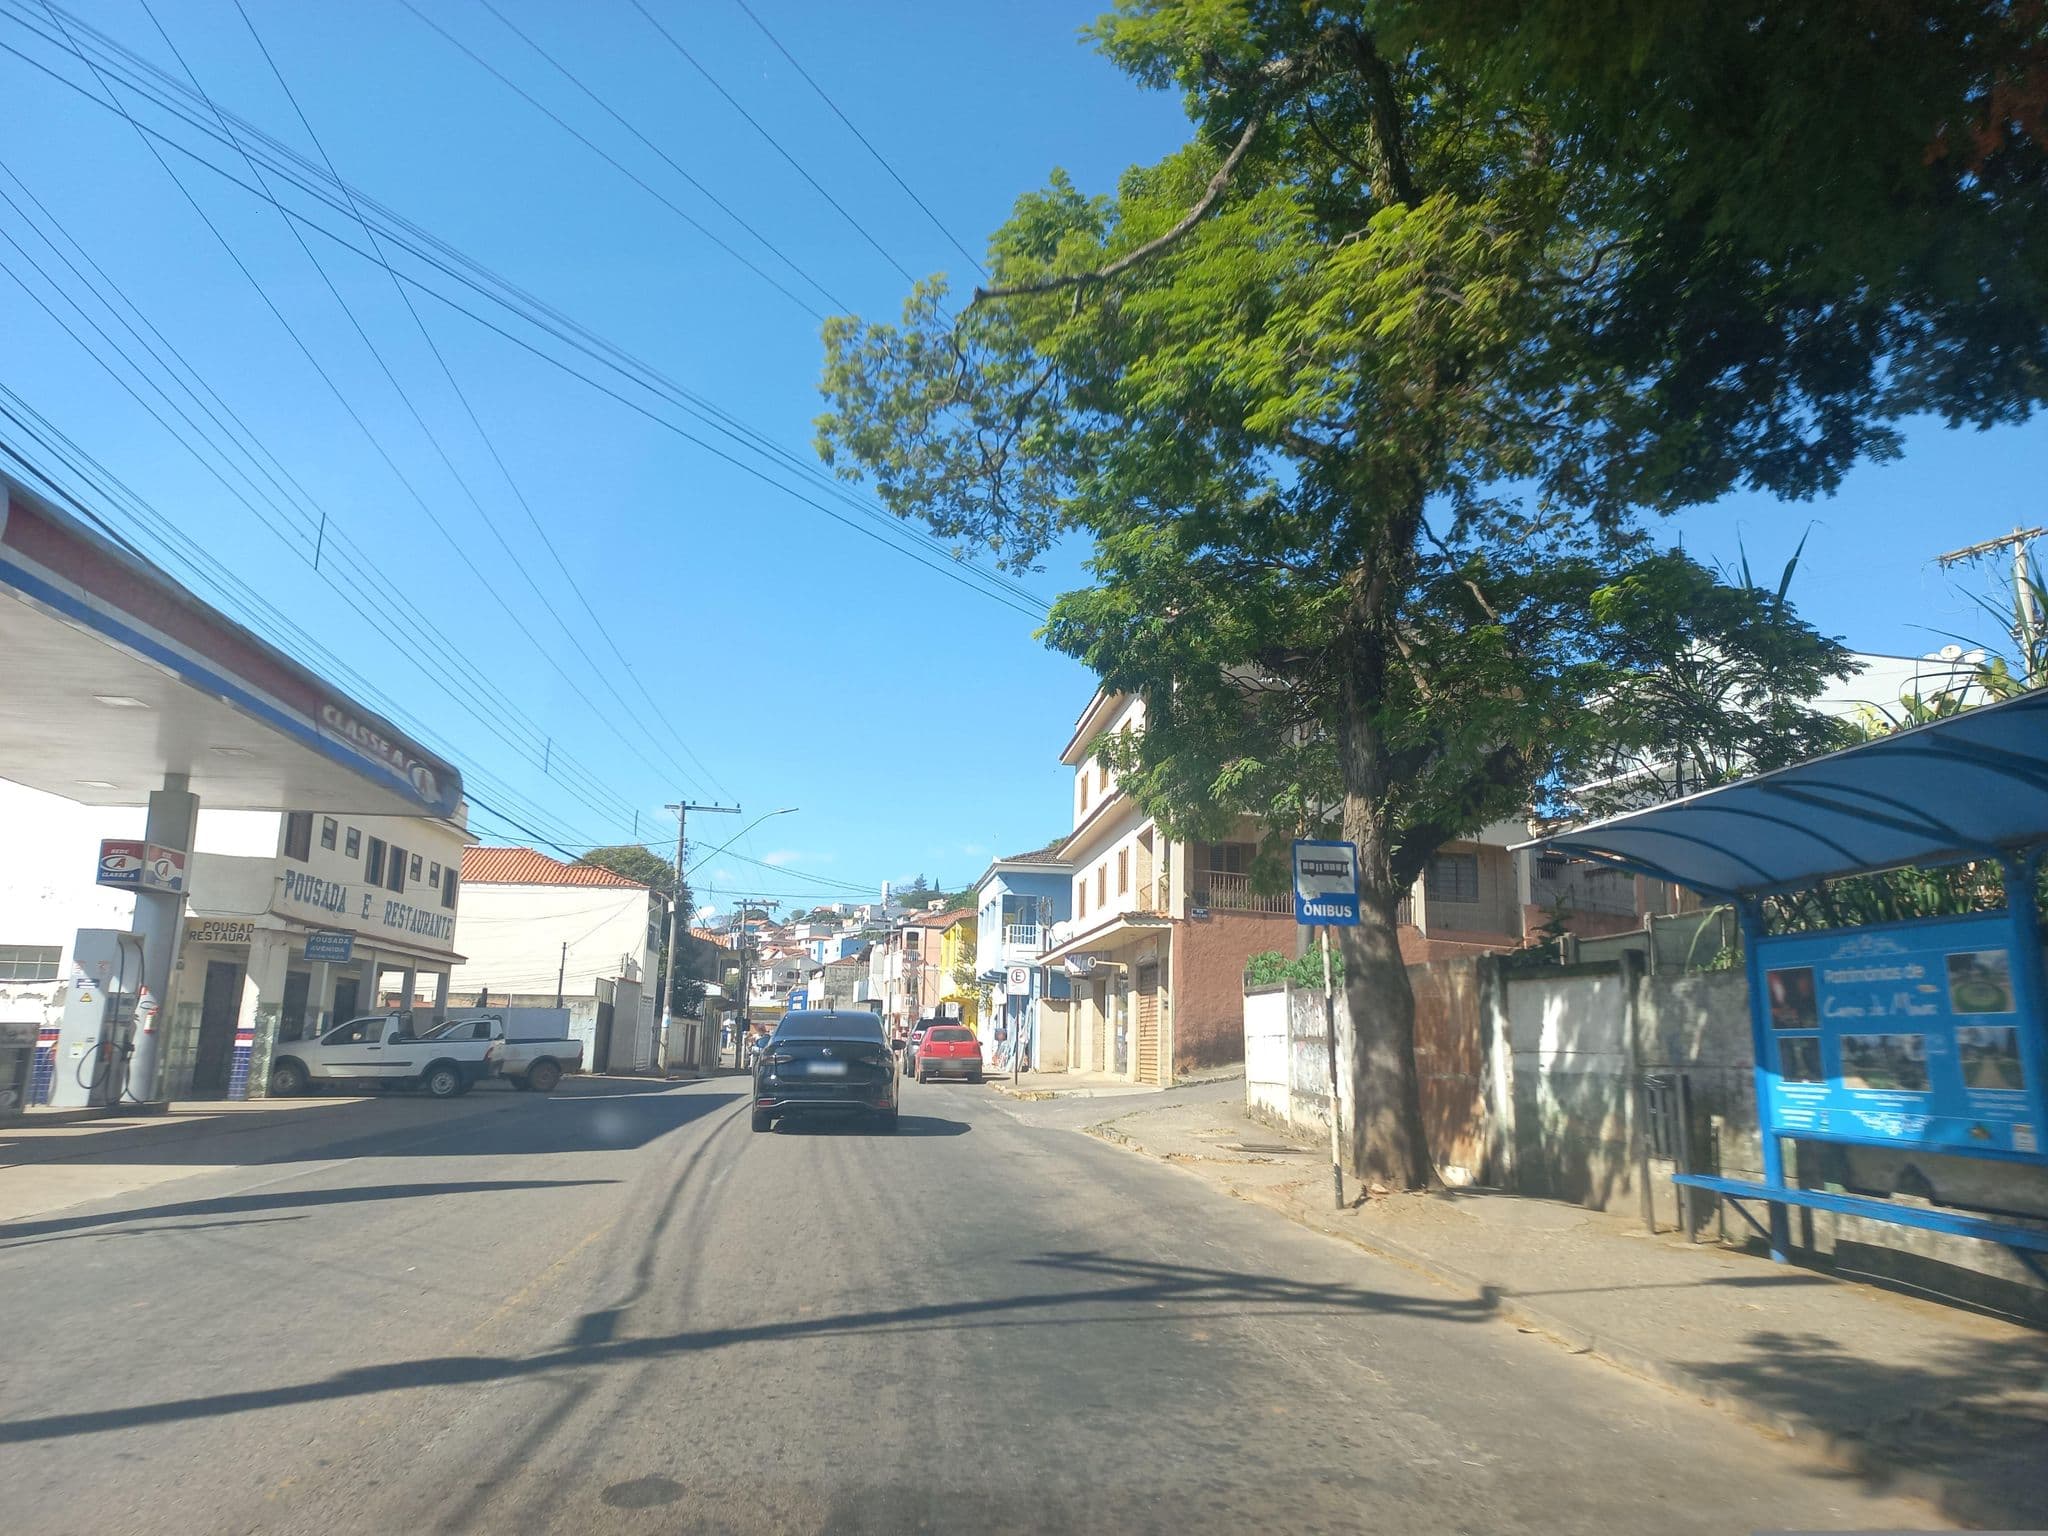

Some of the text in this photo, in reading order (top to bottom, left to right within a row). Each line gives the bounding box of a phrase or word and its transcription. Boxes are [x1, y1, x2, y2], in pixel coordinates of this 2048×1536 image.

[322, 704, 404, 768] CLASSE A
[284, 869, 454, 940] POUSADA E RESTAURANTE
[1303, 900, 1353, 918] ÔNIBUS
[203, 921, 255, 934] POUSAD
[190, 931, 251, 942] RESTAURA
[310, 935, 350, 945] POUSADA
[1015, 971, 1021, 981] E
